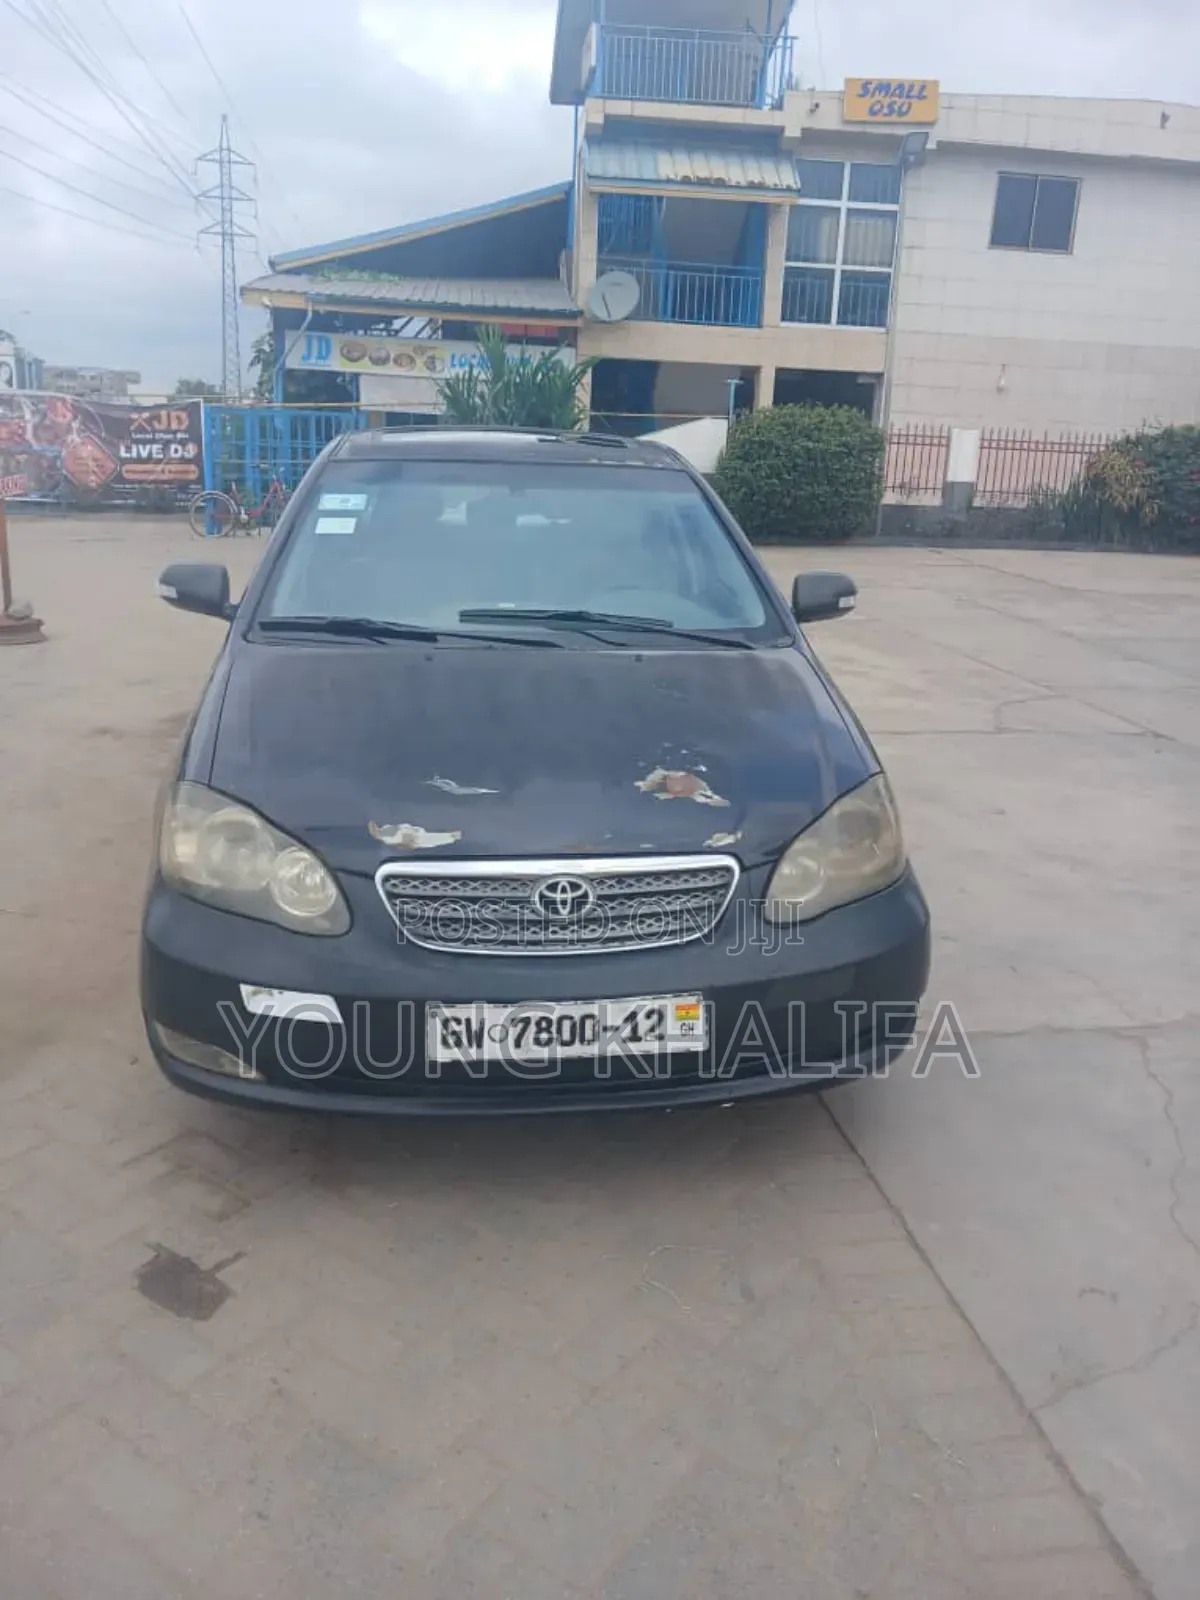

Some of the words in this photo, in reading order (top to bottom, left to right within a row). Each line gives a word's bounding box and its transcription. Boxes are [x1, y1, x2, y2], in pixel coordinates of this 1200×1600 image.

[856, 80, 928, 100] SMALL
[868, 100, 912, 118] OSU
[301, 334, 333, 361] JD
[152, 410, 189, 430] JD
[119, 443, 164, 459] LIVE
[170, 442, 197, 459] DJ
[440, 1016, 484, 1050] GW
[510, 1008, 665, 1050] 7800-12
[679, 1021, 695, 1036] GH
